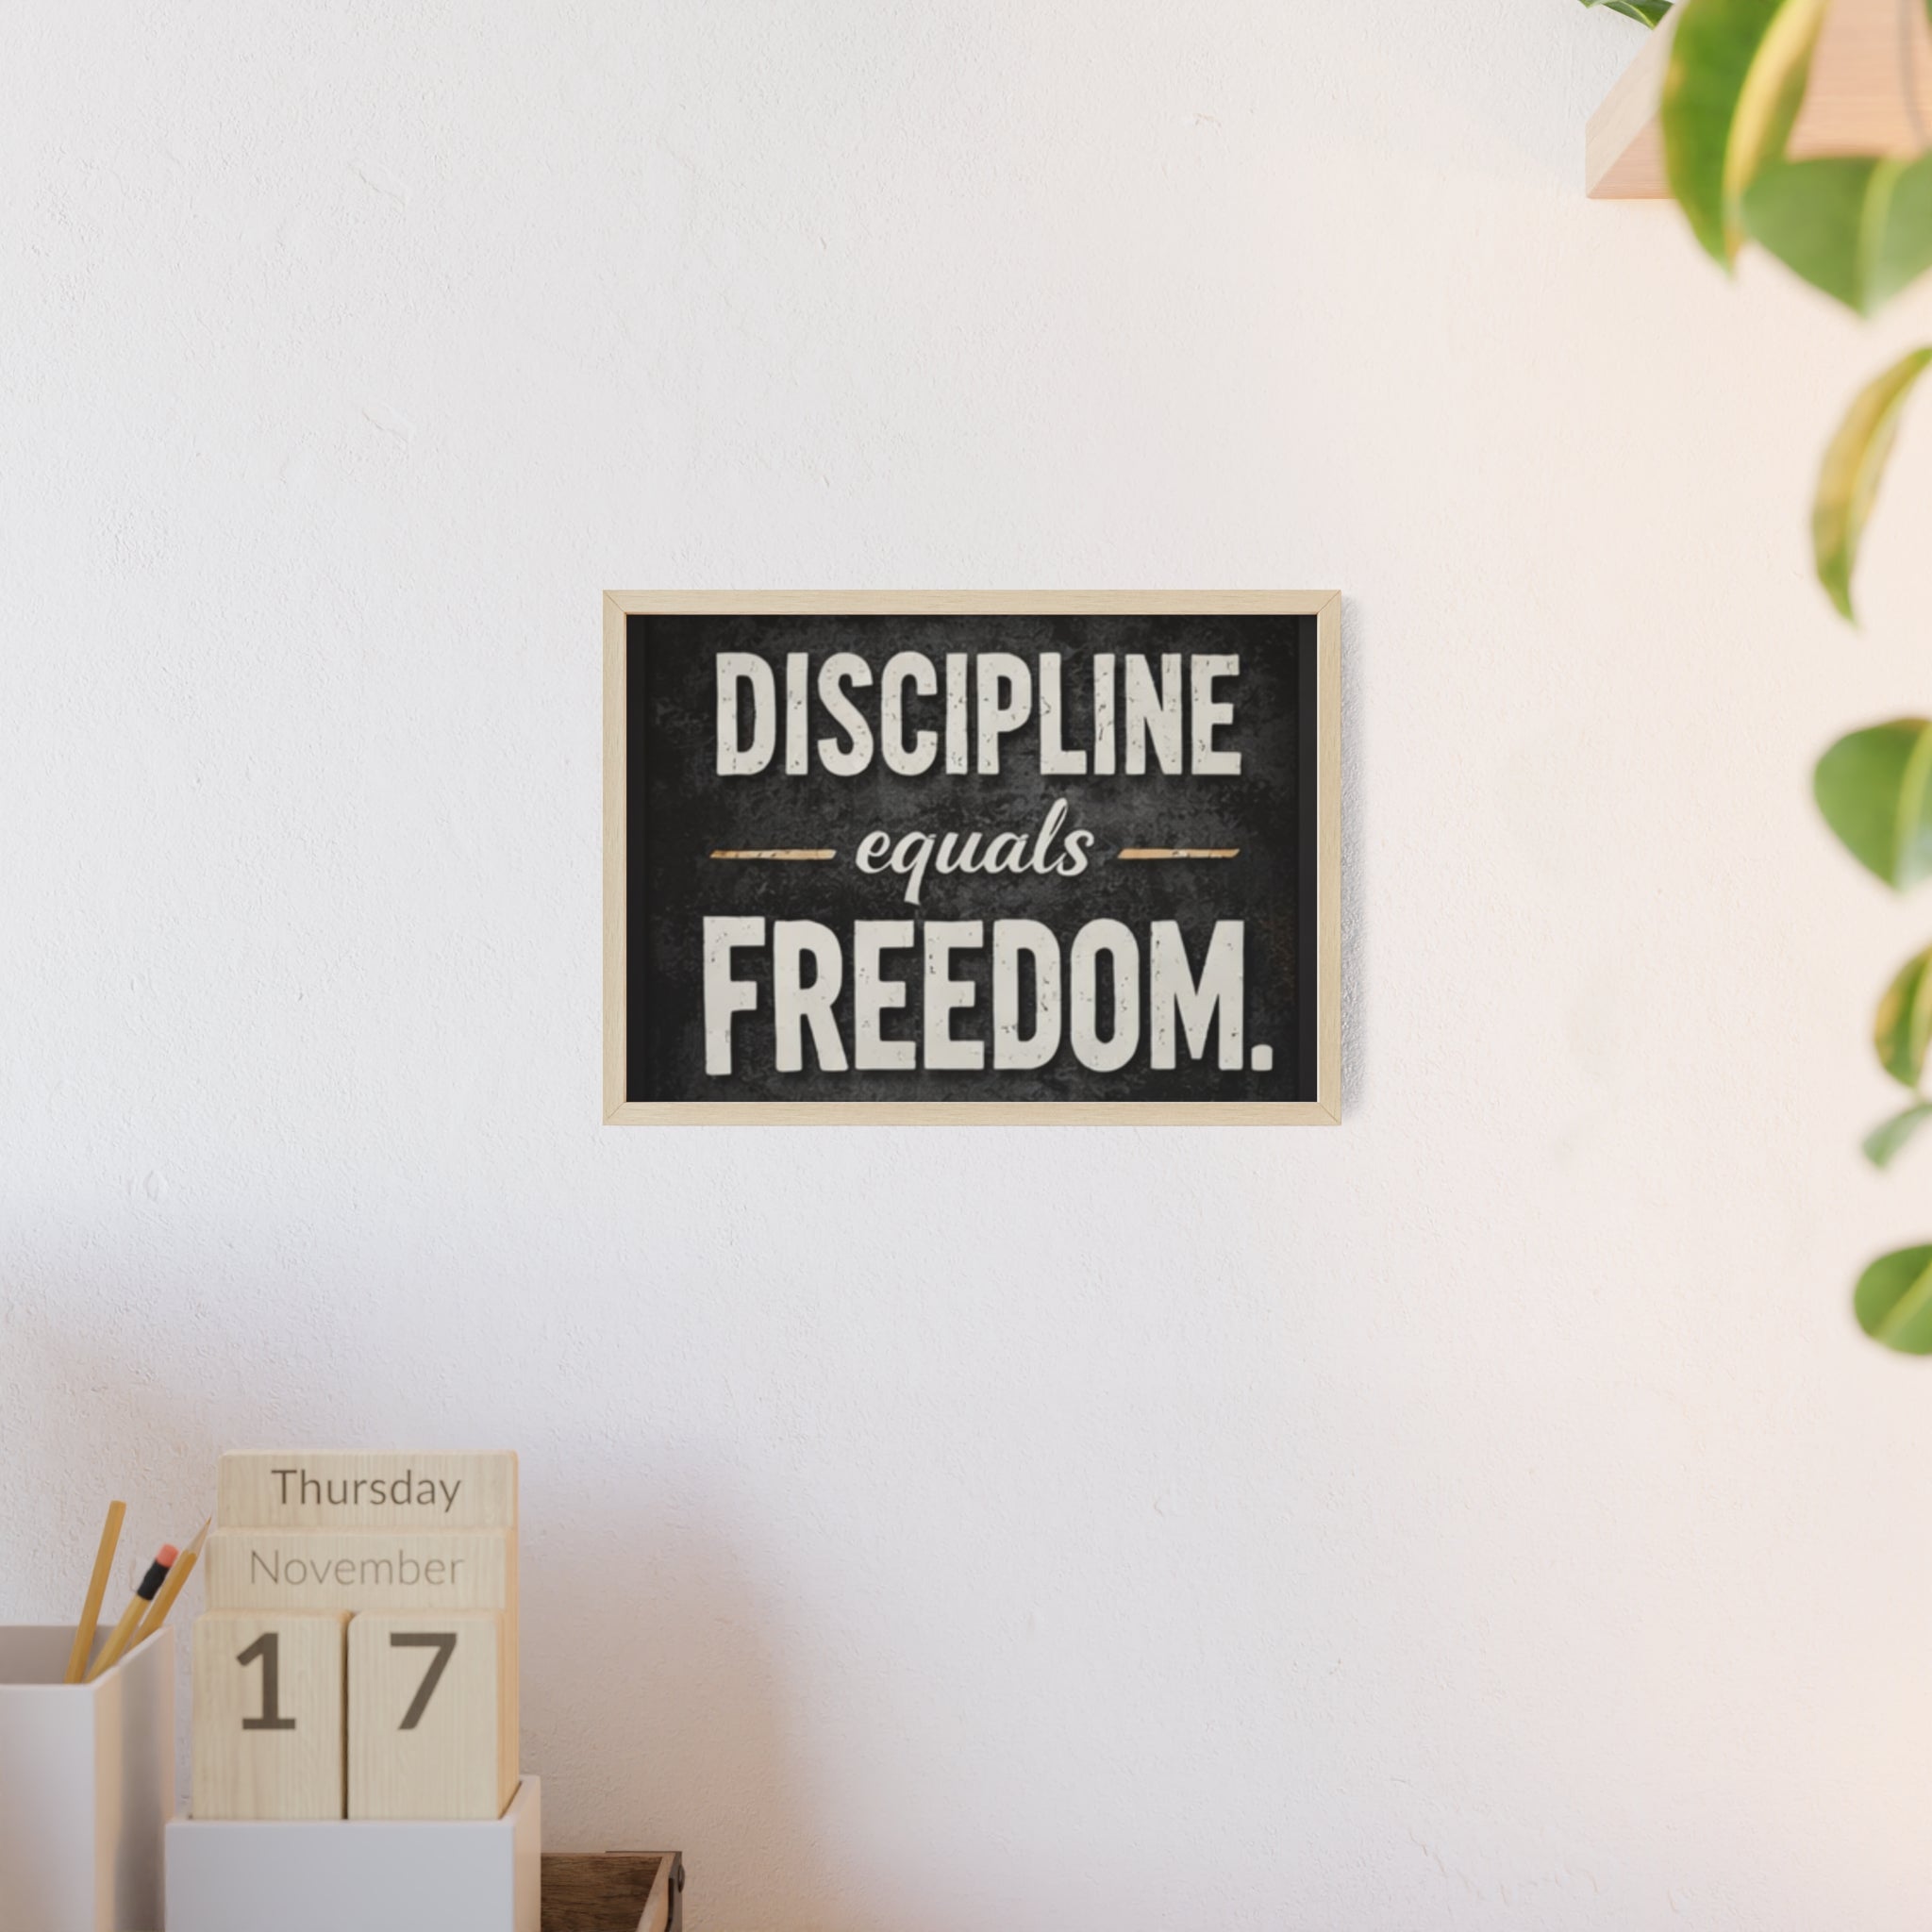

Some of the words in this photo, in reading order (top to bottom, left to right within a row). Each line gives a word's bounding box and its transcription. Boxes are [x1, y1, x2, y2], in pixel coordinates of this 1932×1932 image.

[715, 650, 1242, 776] DISCIPLINE
[855, 797, 1095, 905] equals
[702, 915, 1274, 1075] FREEDOM.
[271, 1468, 462, 1513] Thursday
[249, 1549, 466, 1587] November
